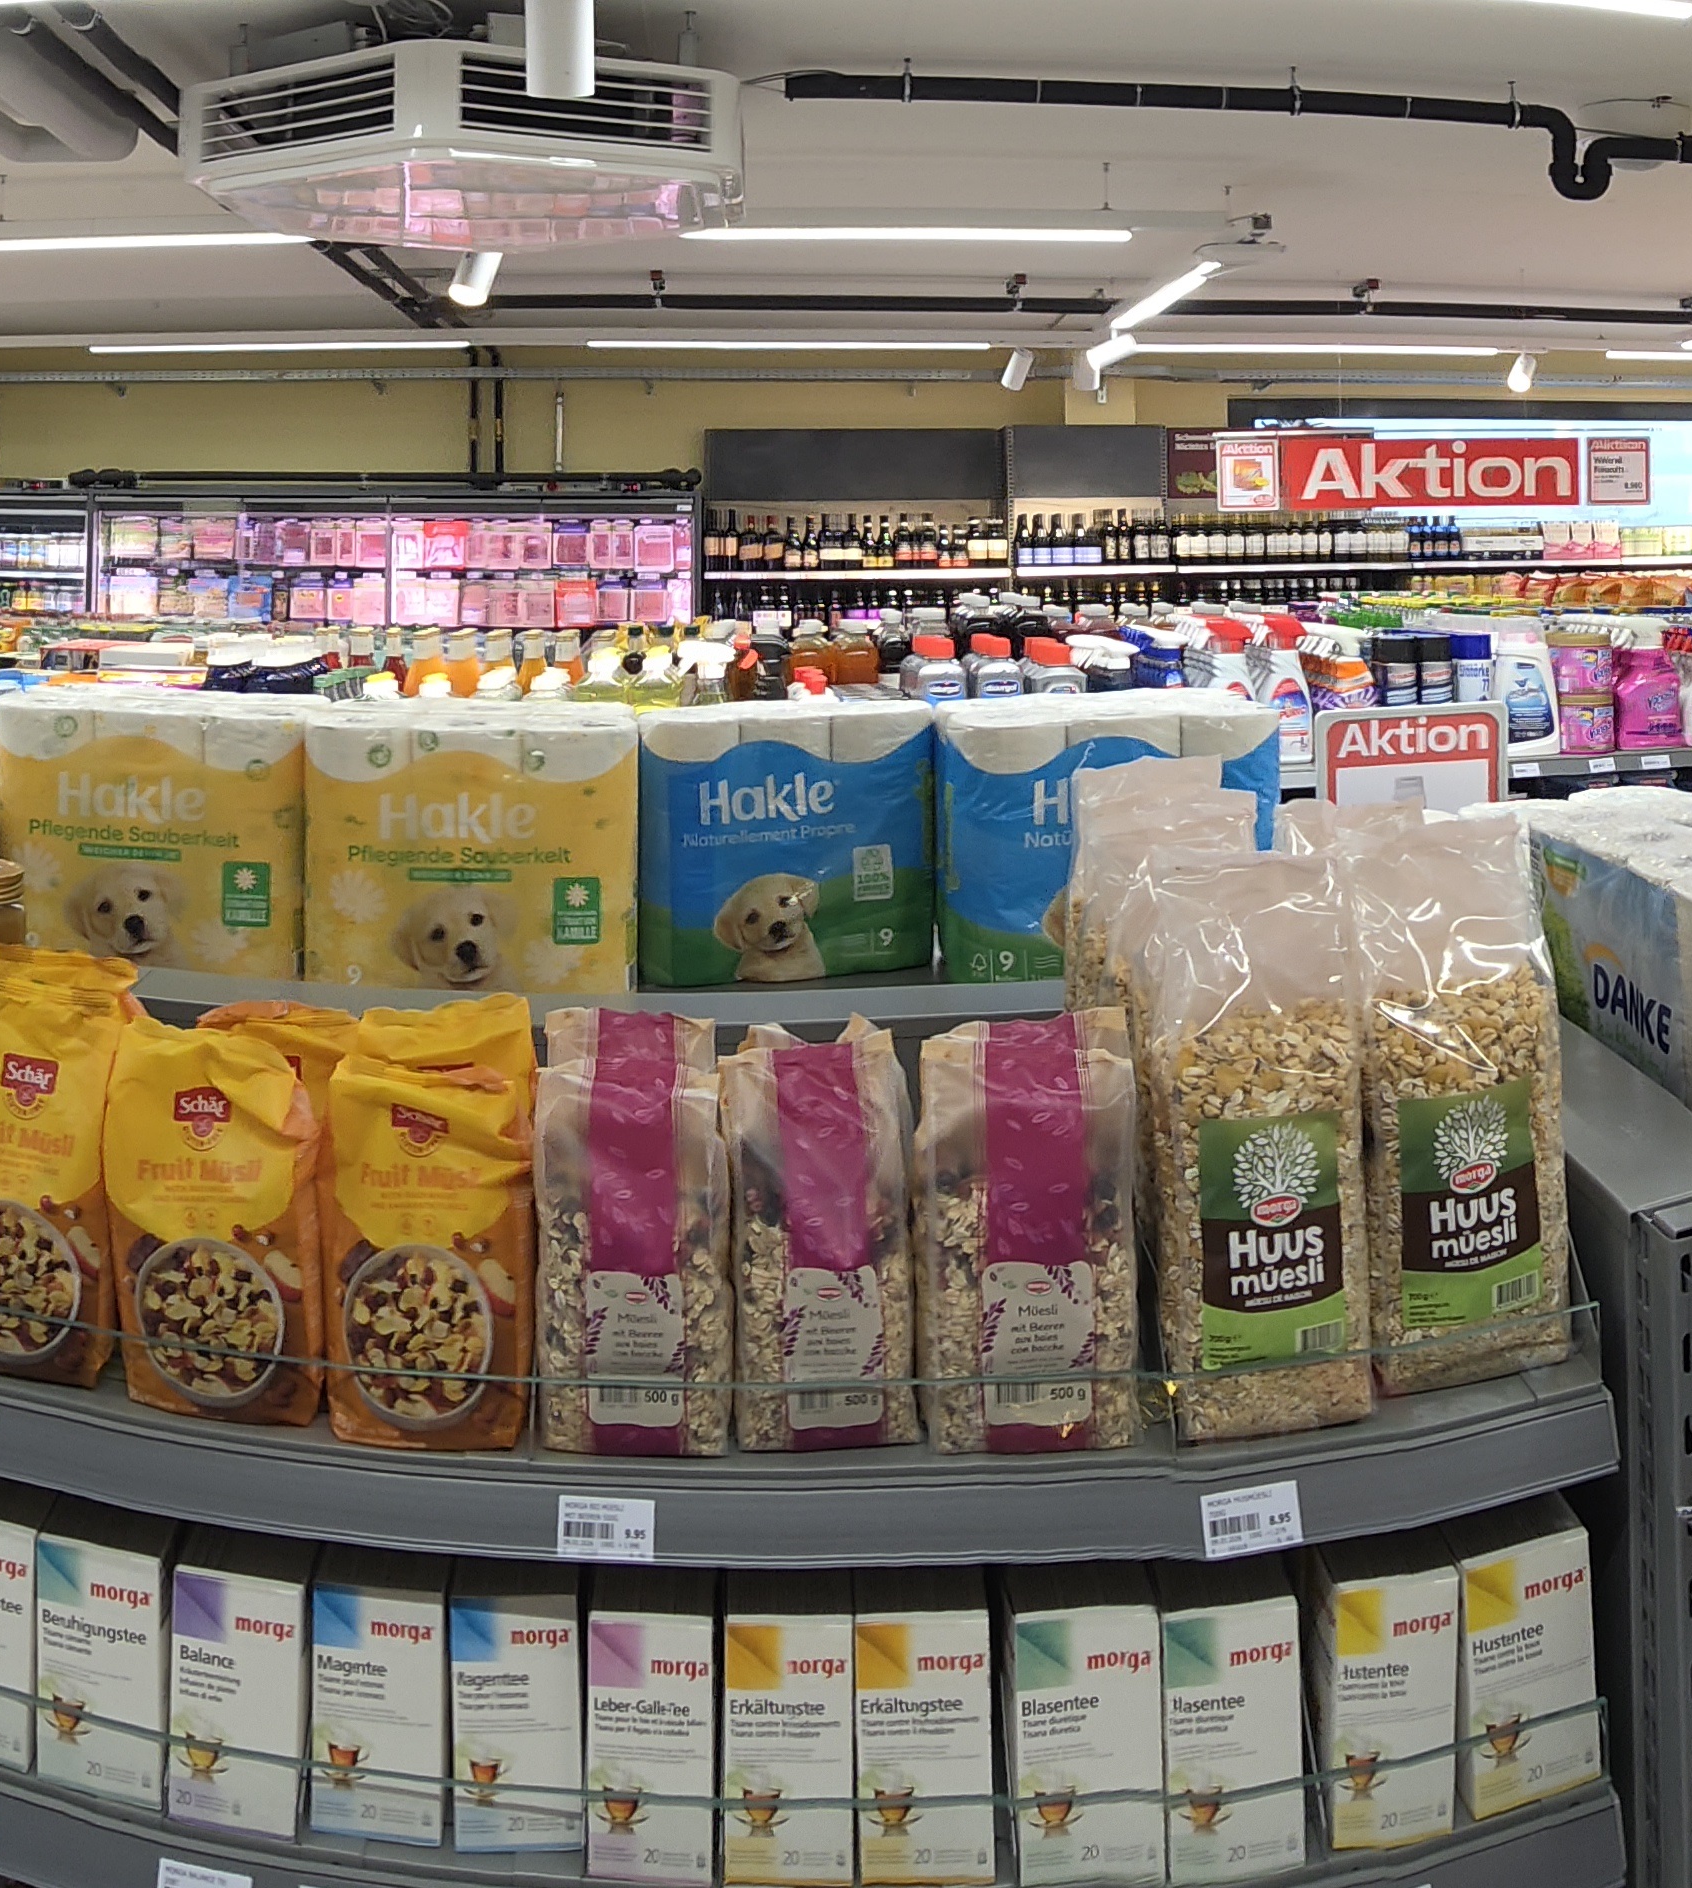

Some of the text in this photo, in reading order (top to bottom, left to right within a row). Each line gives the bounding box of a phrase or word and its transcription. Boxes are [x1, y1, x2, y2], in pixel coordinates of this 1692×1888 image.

[1300, 440, 1572, 500] Aktion
[1337, 717, 1490, 759] Aktion
[57, 771, 207, 825] Hakle
[698, 771, 836, 826] Hakle
[28, 818, 125, 843] Pflegende
[378, 792, 537, 844] Hakle
[877, 927, 894, 947] 9
[998, 951, 1015, 971] 9
[347, 965, 363, 986] 9
[1592, 960, 1672, 1056] DANKE
[4, 1060, 54, 1092] Schär
[177, 1094, 227, 1119] Schär
[137, 1157, 196, 1182] Fruit
[1431, 1214, 1518, 1259] müesli
[1231, 1257, 1325, 1296] müesli
[1017, 1303, 1059, 1317] Müesli
[1032, 1321, 1065, 1332] Beeren
[644, 1389, 679, 1405] 500 g
[1049, 1386, 1086, 1401] 500 g
[1269, 1512, 1292, 1526] 8.95
[624, 1528, 646, 1540] 9.95
[90, 1581, 151, 1609] morga
[1524, 1566, 1586, 1601] morga
[235, 1615, 295, 1642] morga
[370, 1619, 433, 1645] morga
[1392, 1610, 1453, 1639] morga
[510, 1627, 571, 1649] morga
[1472, 1622, 1545, 1656] Hustentee
[180, 1645, 236, 1670] Balance
[917, 1652, 984, 1676] morga
[1086, 1650, 1152, 1674] morga
[1229, 1641, 1293, 1667] morga
[650, 1658, 709, 1682] morga
[1021, 1693, 1101, 1718] Blasentee
[86, 1761, 102, 1778] 20
[1527, 1764, 1544, 1783] 20
[175, 1789, 192, 1806] 20
[361, 1804, 377, 1820] 20
